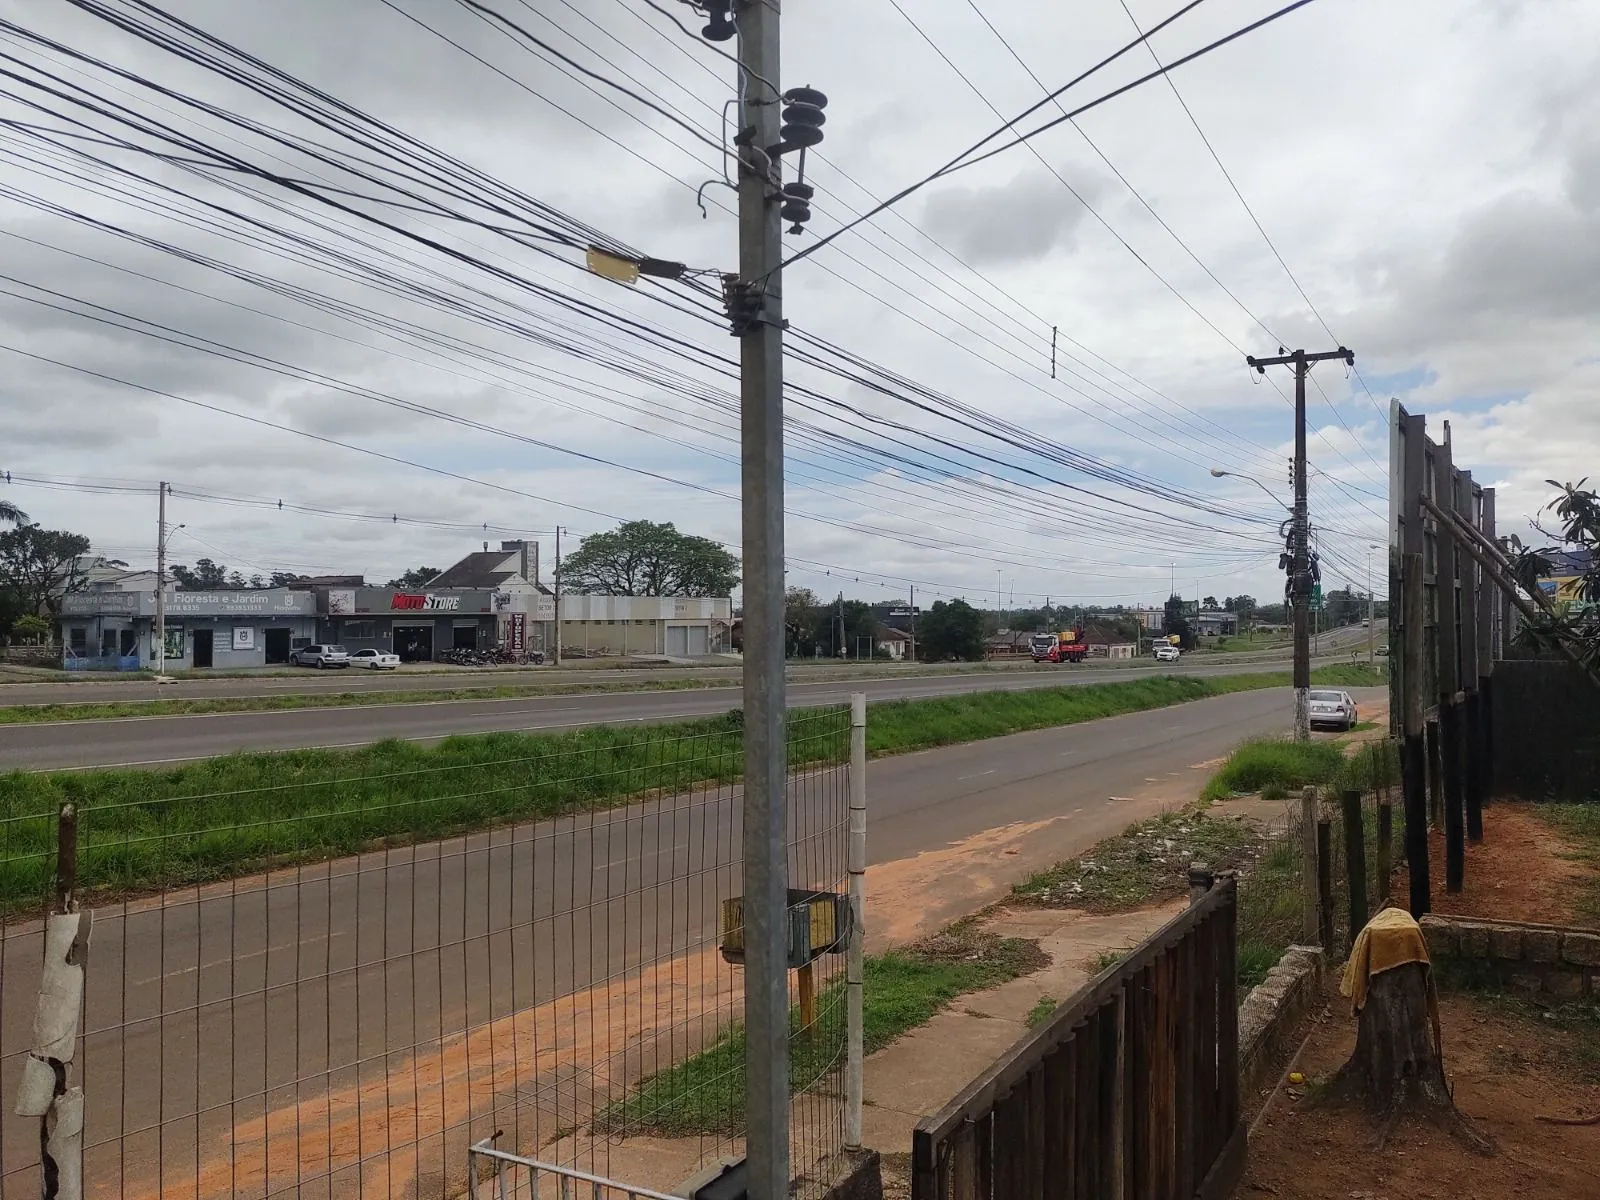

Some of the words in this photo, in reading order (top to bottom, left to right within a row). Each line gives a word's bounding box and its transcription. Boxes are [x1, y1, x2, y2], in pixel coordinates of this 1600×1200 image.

[174, 593, 219, 604] Floresta
[221, 595, 229, 604] e
[231, 593, 269, 604] Jardim
